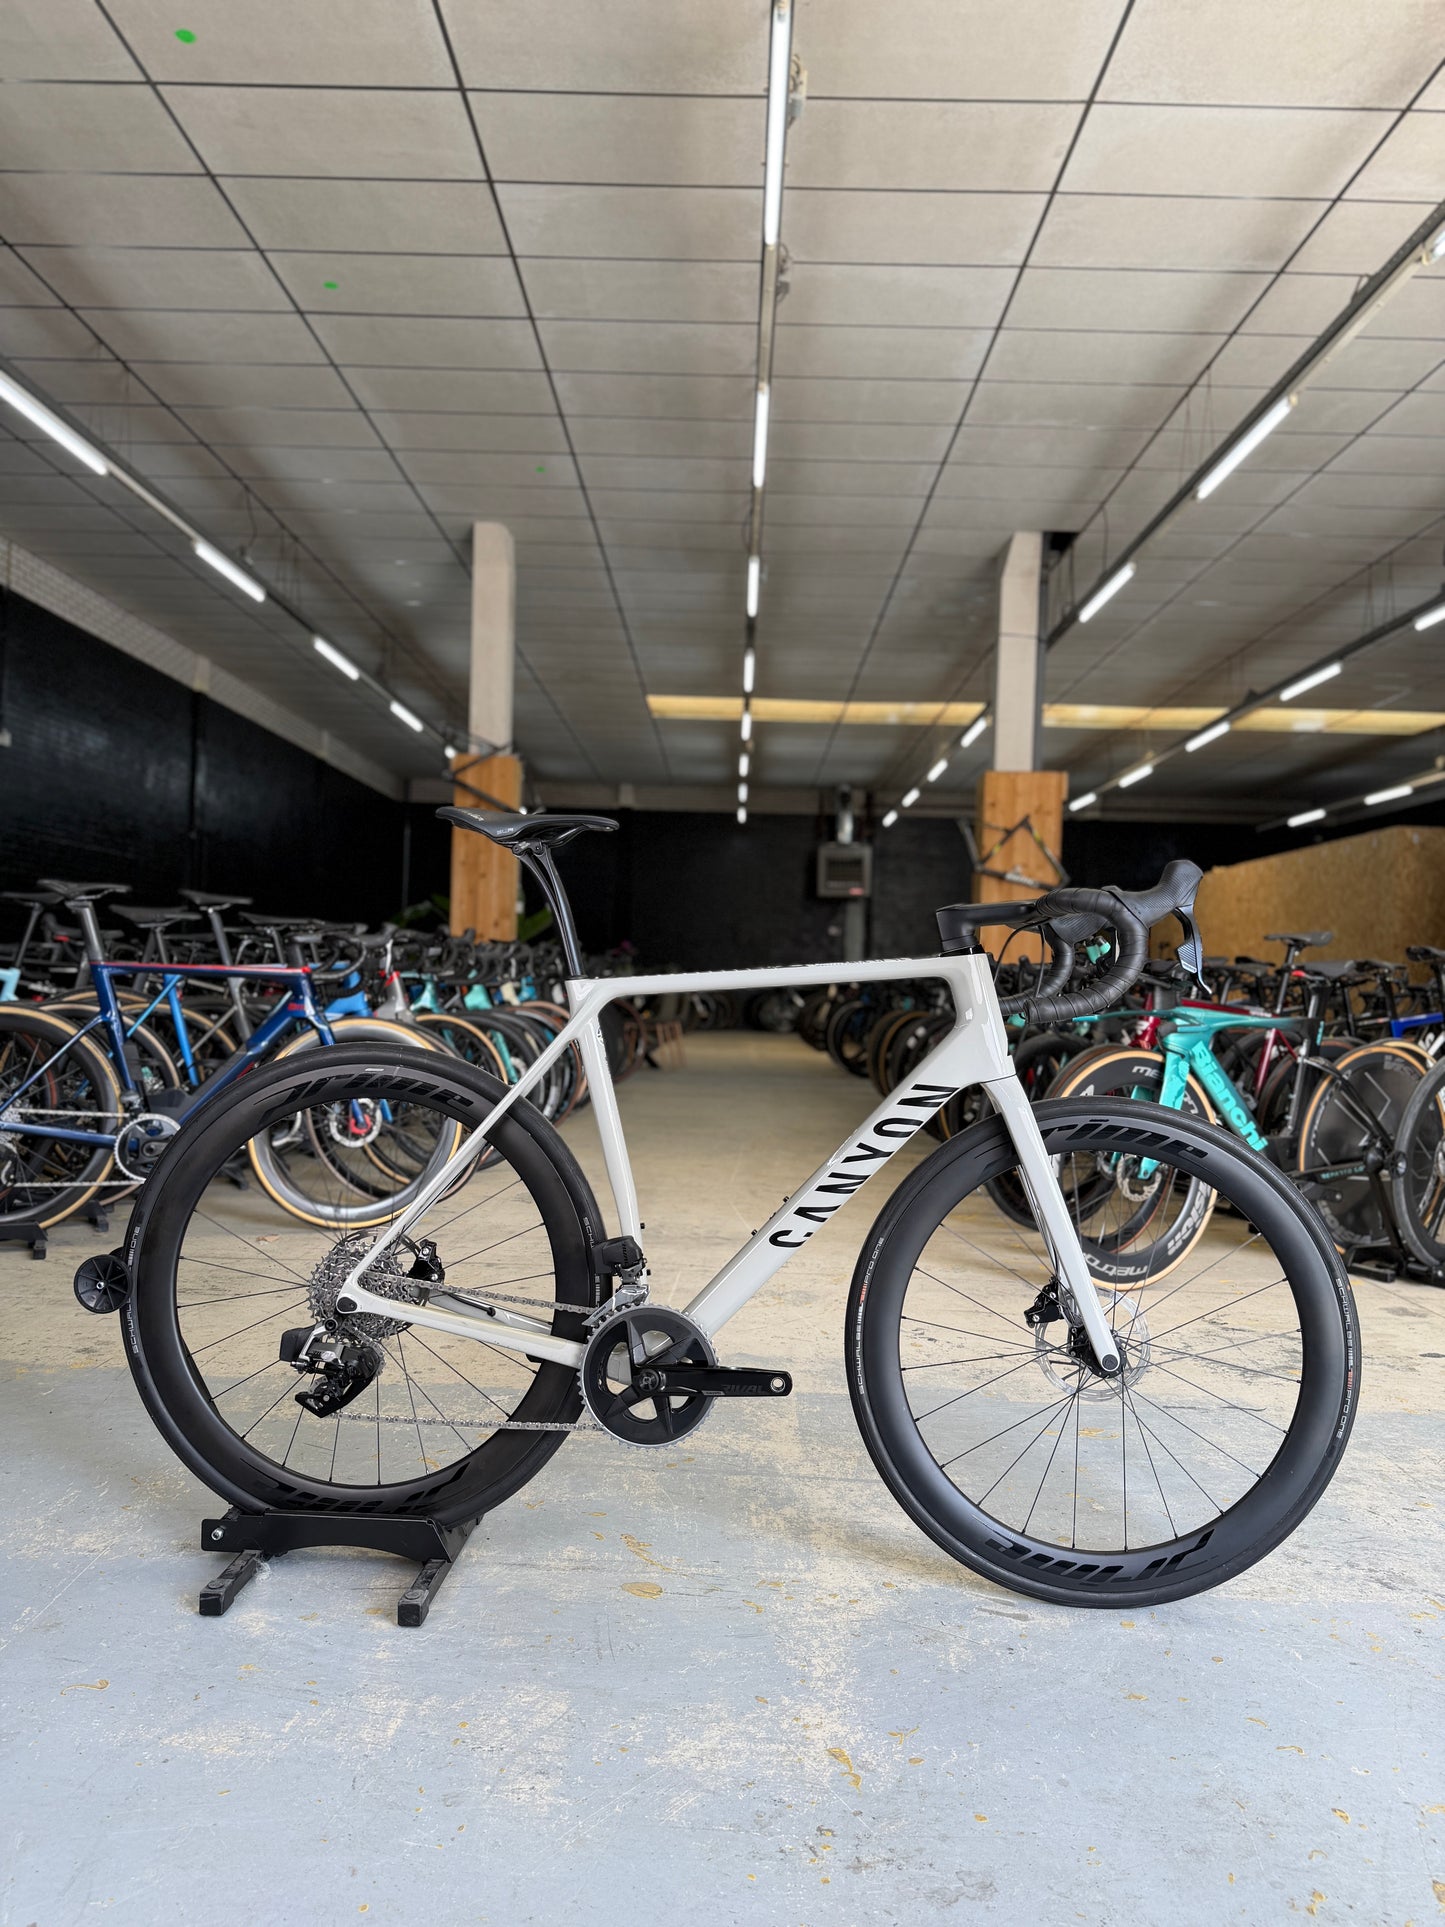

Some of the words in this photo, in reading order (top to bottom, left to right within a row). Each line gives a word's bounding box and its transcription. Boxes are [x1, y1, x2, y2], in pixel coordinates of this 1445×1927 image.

[1191, 1041, 1268, 1151] Bianchi
[769, 1083, 960, 1248] CANYON
[1083, 1251, 1148, 1278] metro
